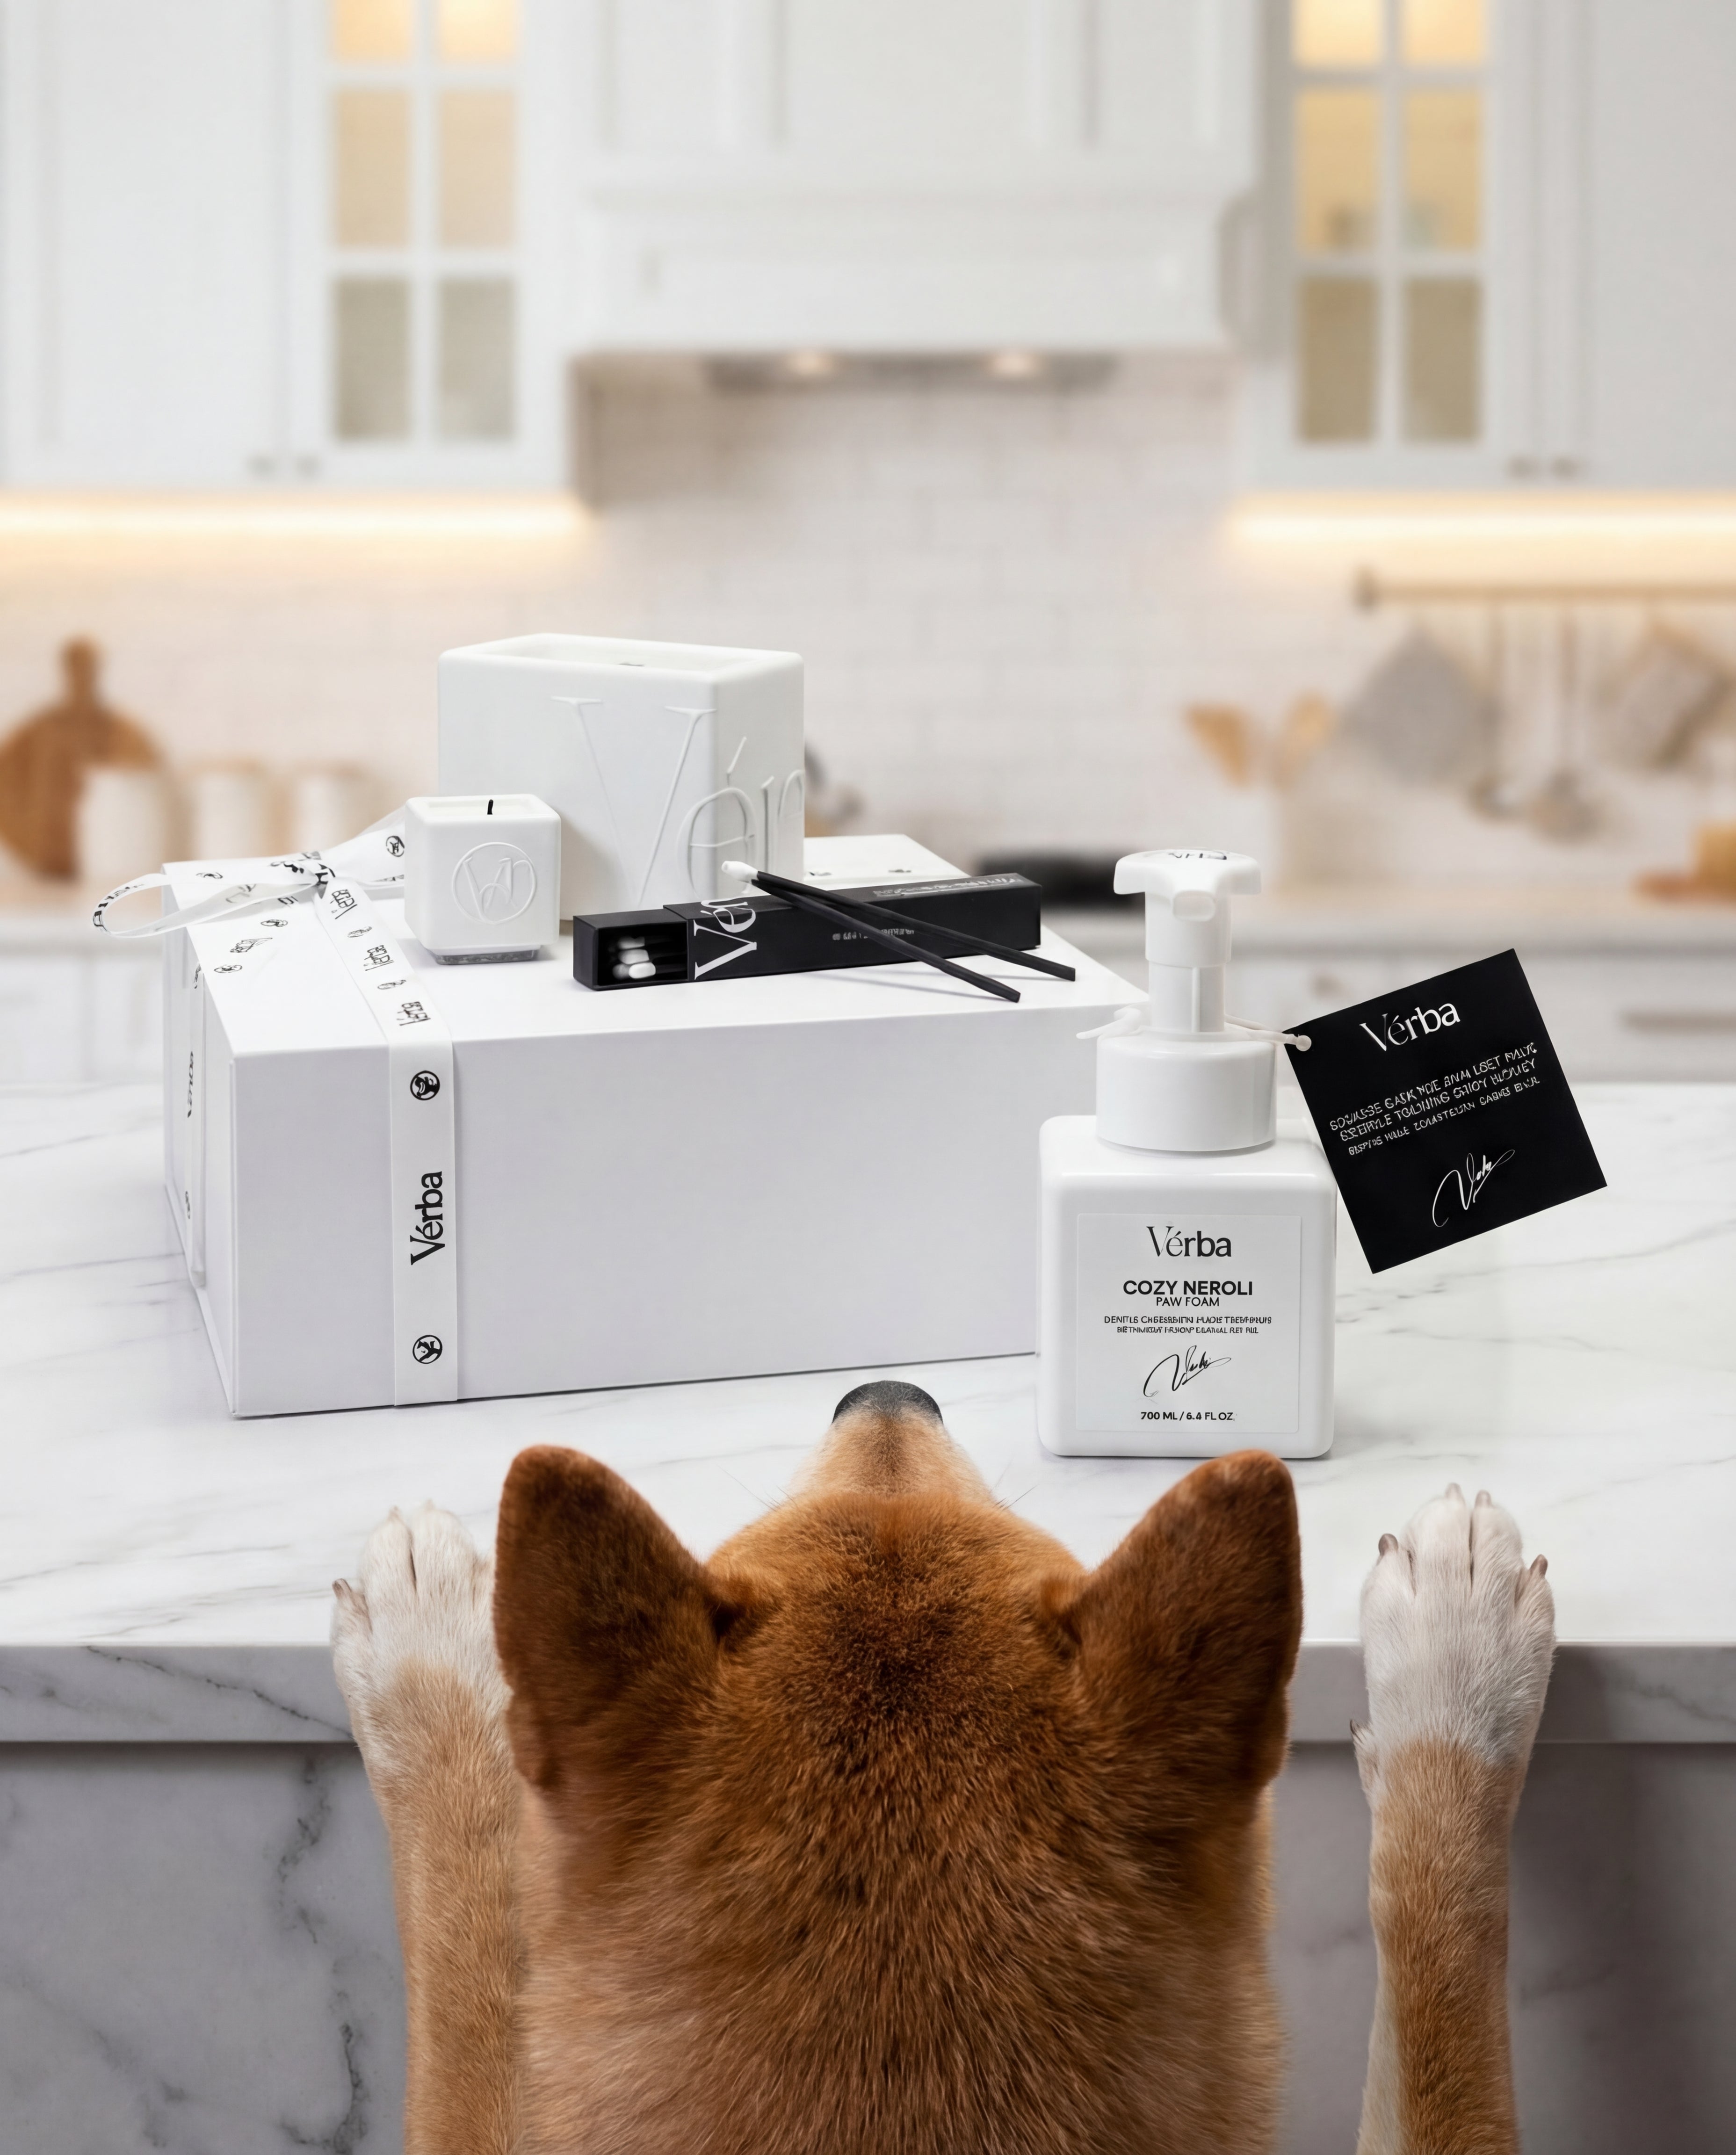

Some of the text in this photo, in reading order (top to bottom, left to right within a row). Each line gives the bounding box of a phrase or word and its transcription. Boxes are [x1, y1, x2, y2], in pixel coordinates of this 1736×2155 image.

[1359, 1003, 1461, 1052] Vérba
[409, 1171, 446, 1266] Vérba
[1146, 1226, 1232, 1258] Vérba
[1123, 1280, 1253, 1295] COZY NEROLI
[1156, 1296, 1219, 1307] PAW FOAM
[1141, 1411, 1160, 1420] 700
[1163, 1411, 1178, 1420] ML
[1186, 1412, 1202, 1420] 6.4
[1205, 1412, 1217, 1420] FL
